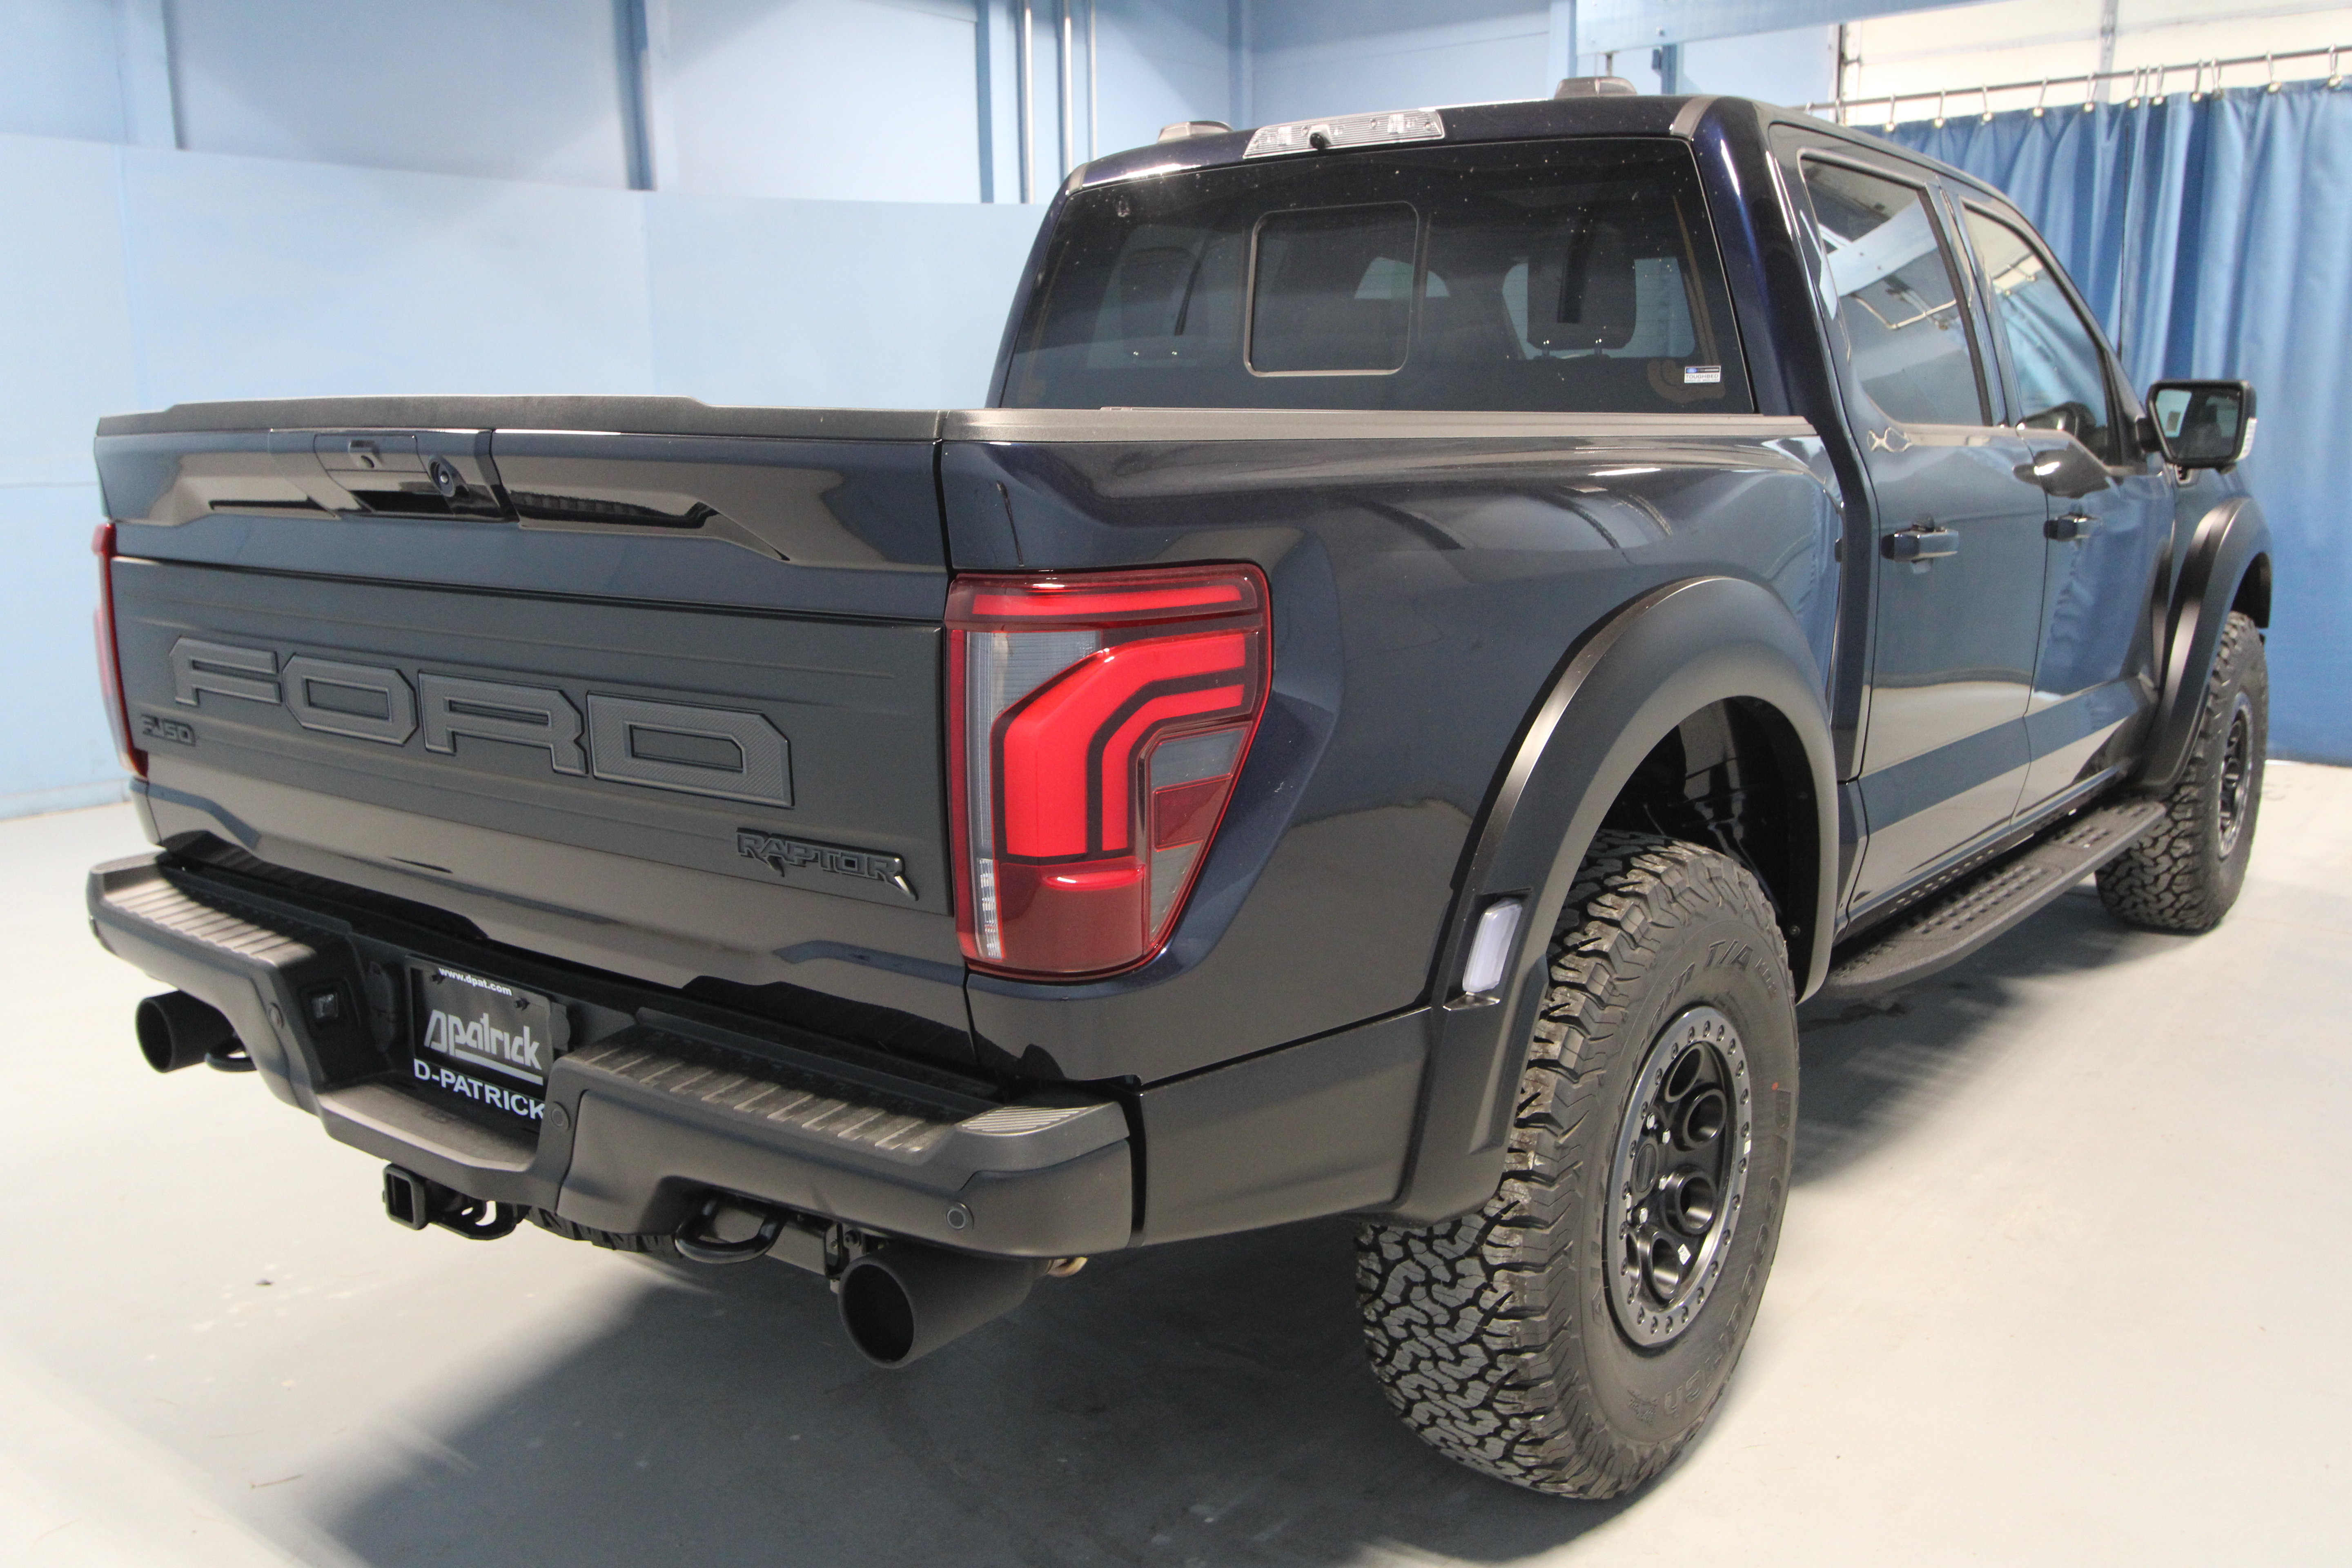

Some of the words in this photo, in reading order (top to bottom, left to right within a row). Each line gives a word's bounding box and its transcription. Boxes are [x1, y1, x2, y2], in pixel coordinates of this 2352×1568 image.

[169, 636, 795, 808] FORD
[736, 827, 918, 901] RAPTOR
[439, 967, 512, 996] www.dpat.com
[414, 1059, 545, 1120] D-PATRICK
